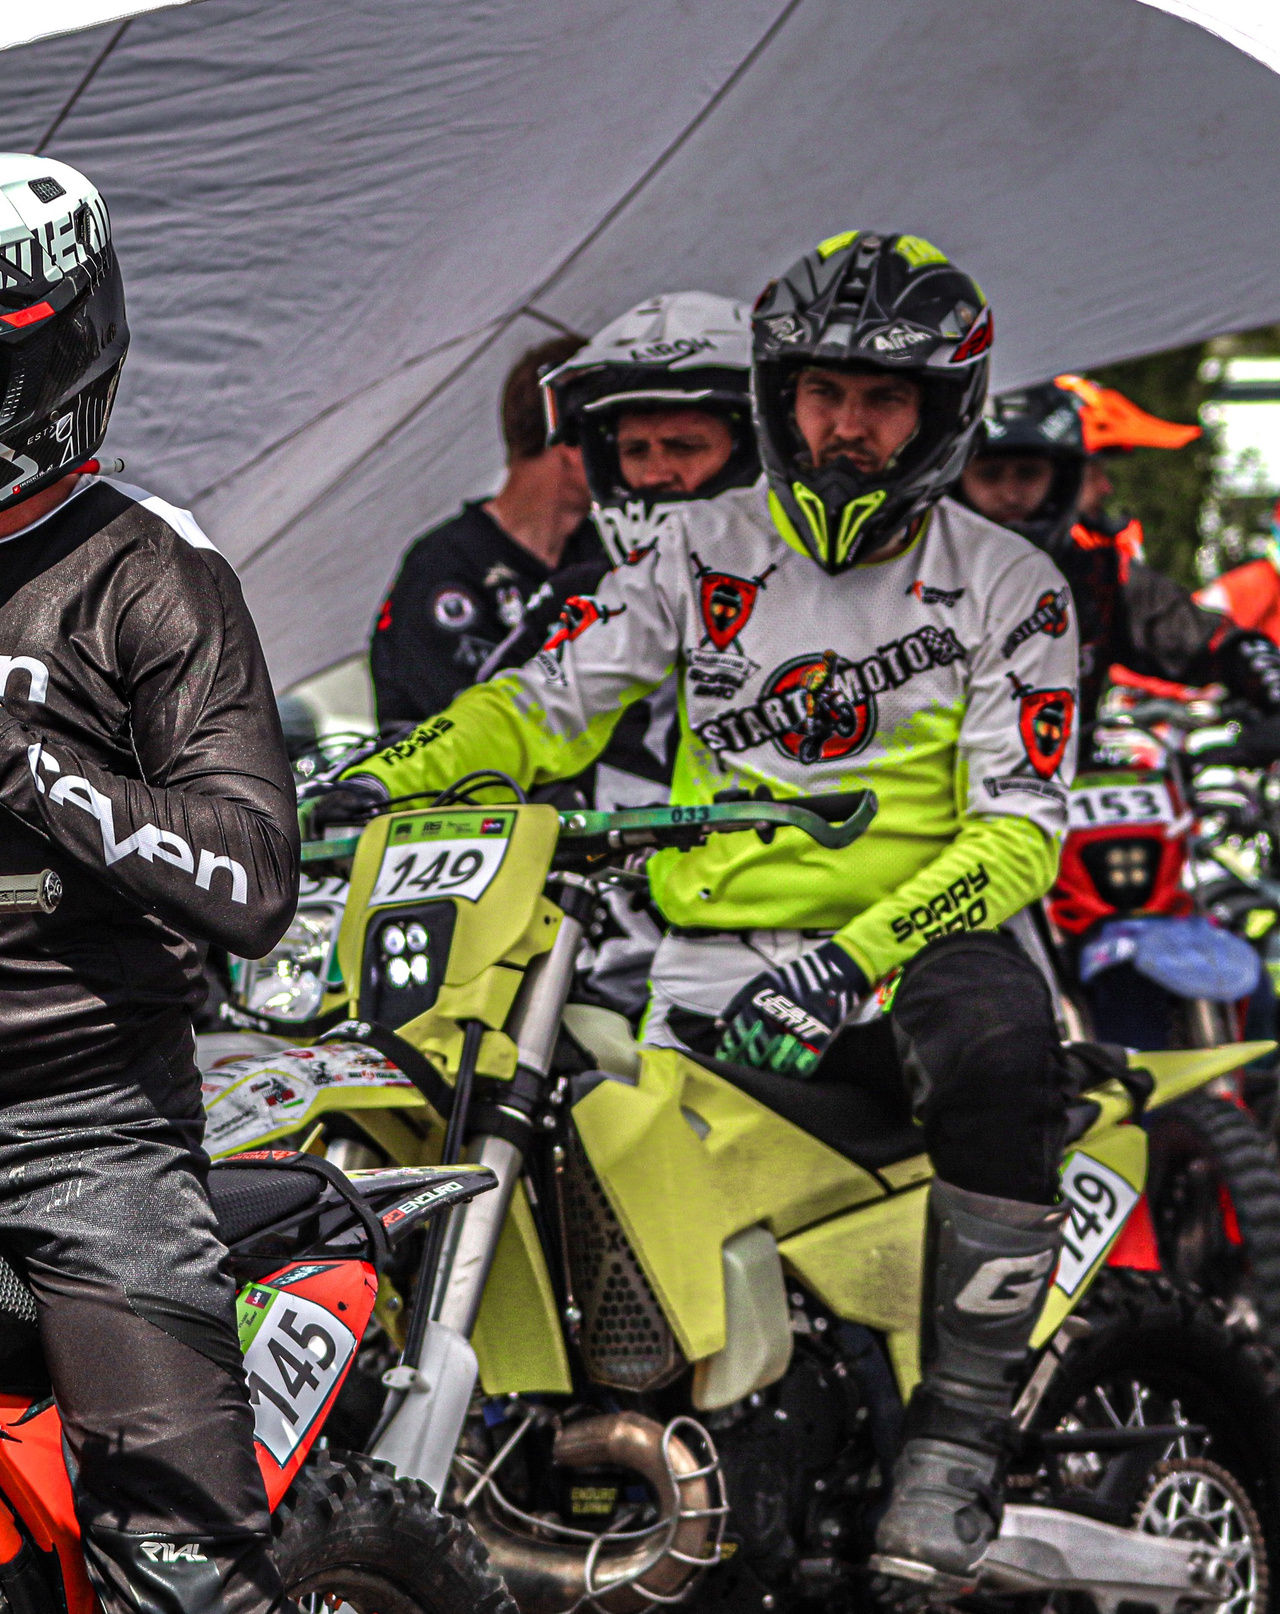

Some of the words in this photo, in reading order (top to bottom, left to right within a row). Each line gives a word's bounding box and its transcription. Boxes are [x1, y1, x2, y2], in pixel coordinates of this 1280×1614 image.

[700, 688, 809, 751] START
[671, 806, 710, 823] 033
[1073, 790, 1161, 822] 153
[386, 849, 485, 896] 149
[891, 862, 991, 944] SORRY
[751, 987, 834, 1040] LEATT
[401, 1181, 465, 1214] ENDURO
[249, 1308, 337, 1427] 145
[138, 1540, 208, 1562] RIVAL
